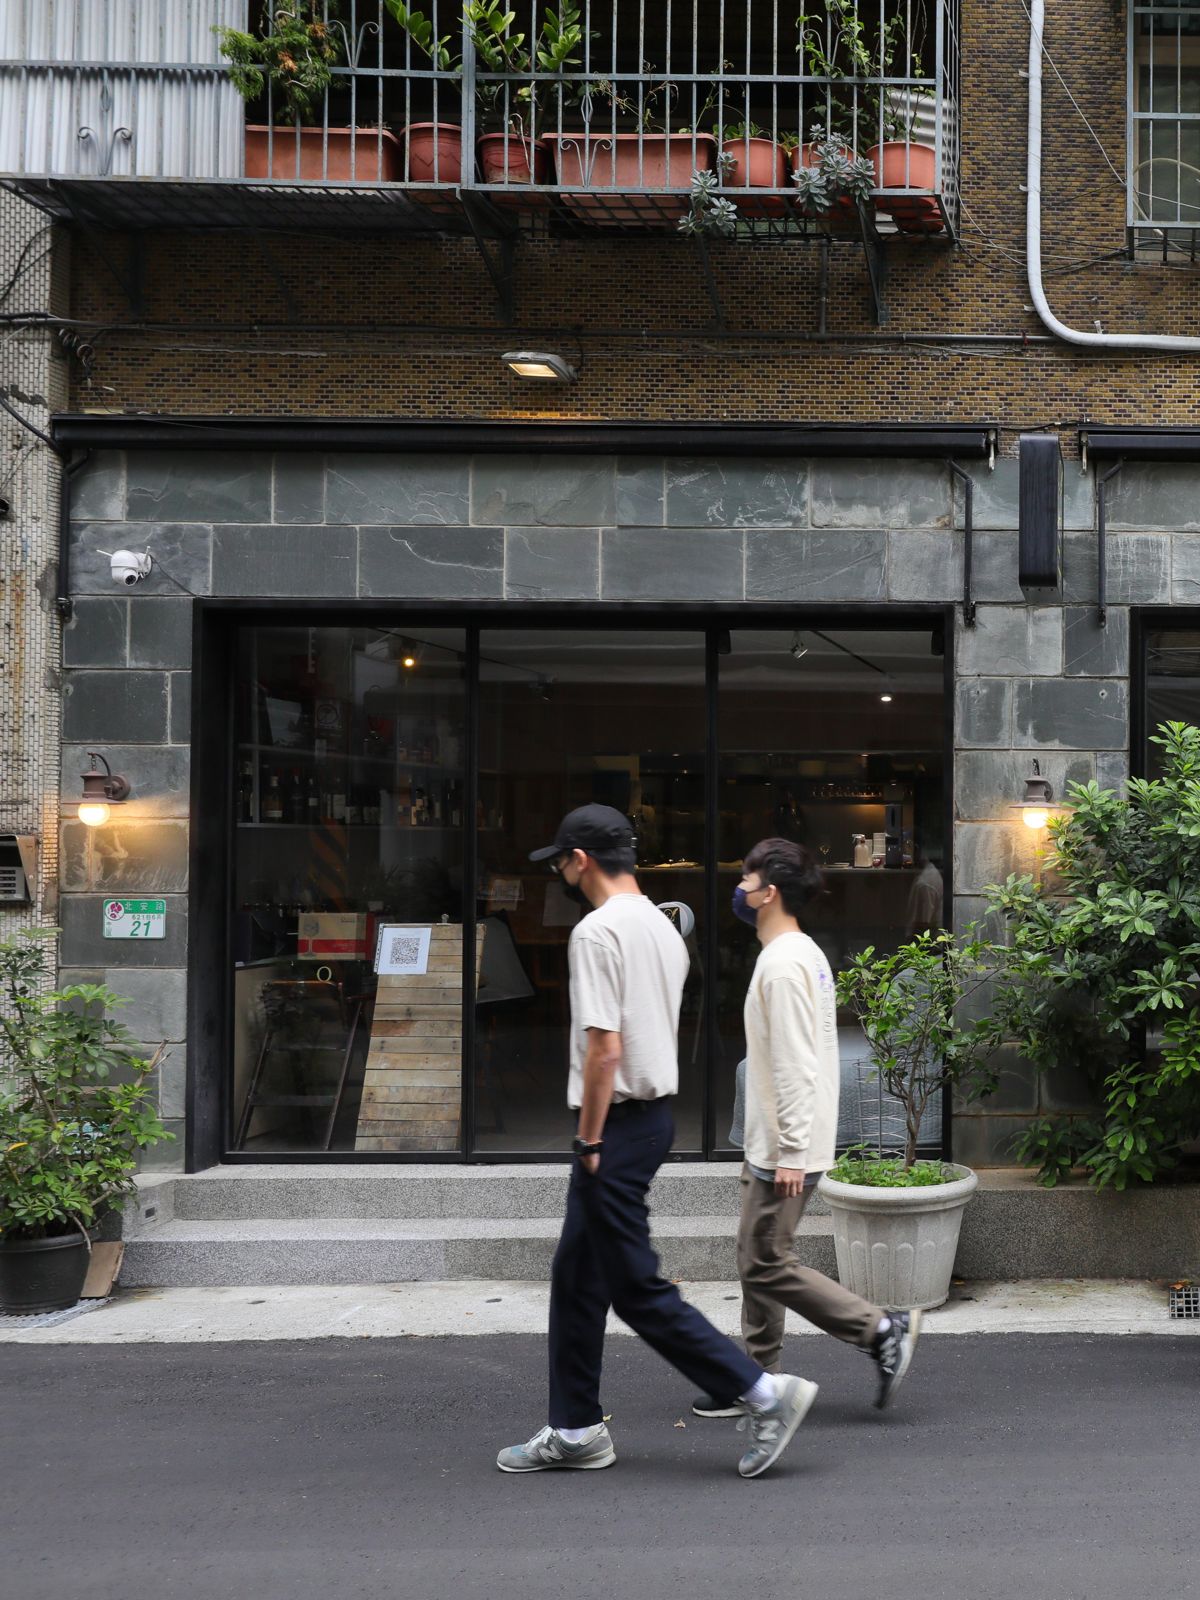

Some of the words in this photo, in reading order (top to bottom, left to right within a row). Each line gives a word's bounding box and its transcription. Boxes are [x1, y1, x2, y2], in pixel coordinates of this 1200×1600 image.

[125, 902, 163, 910] 北安路
[130, 920, 151, 937] 21
[538, 1443, 564, 1463] N
